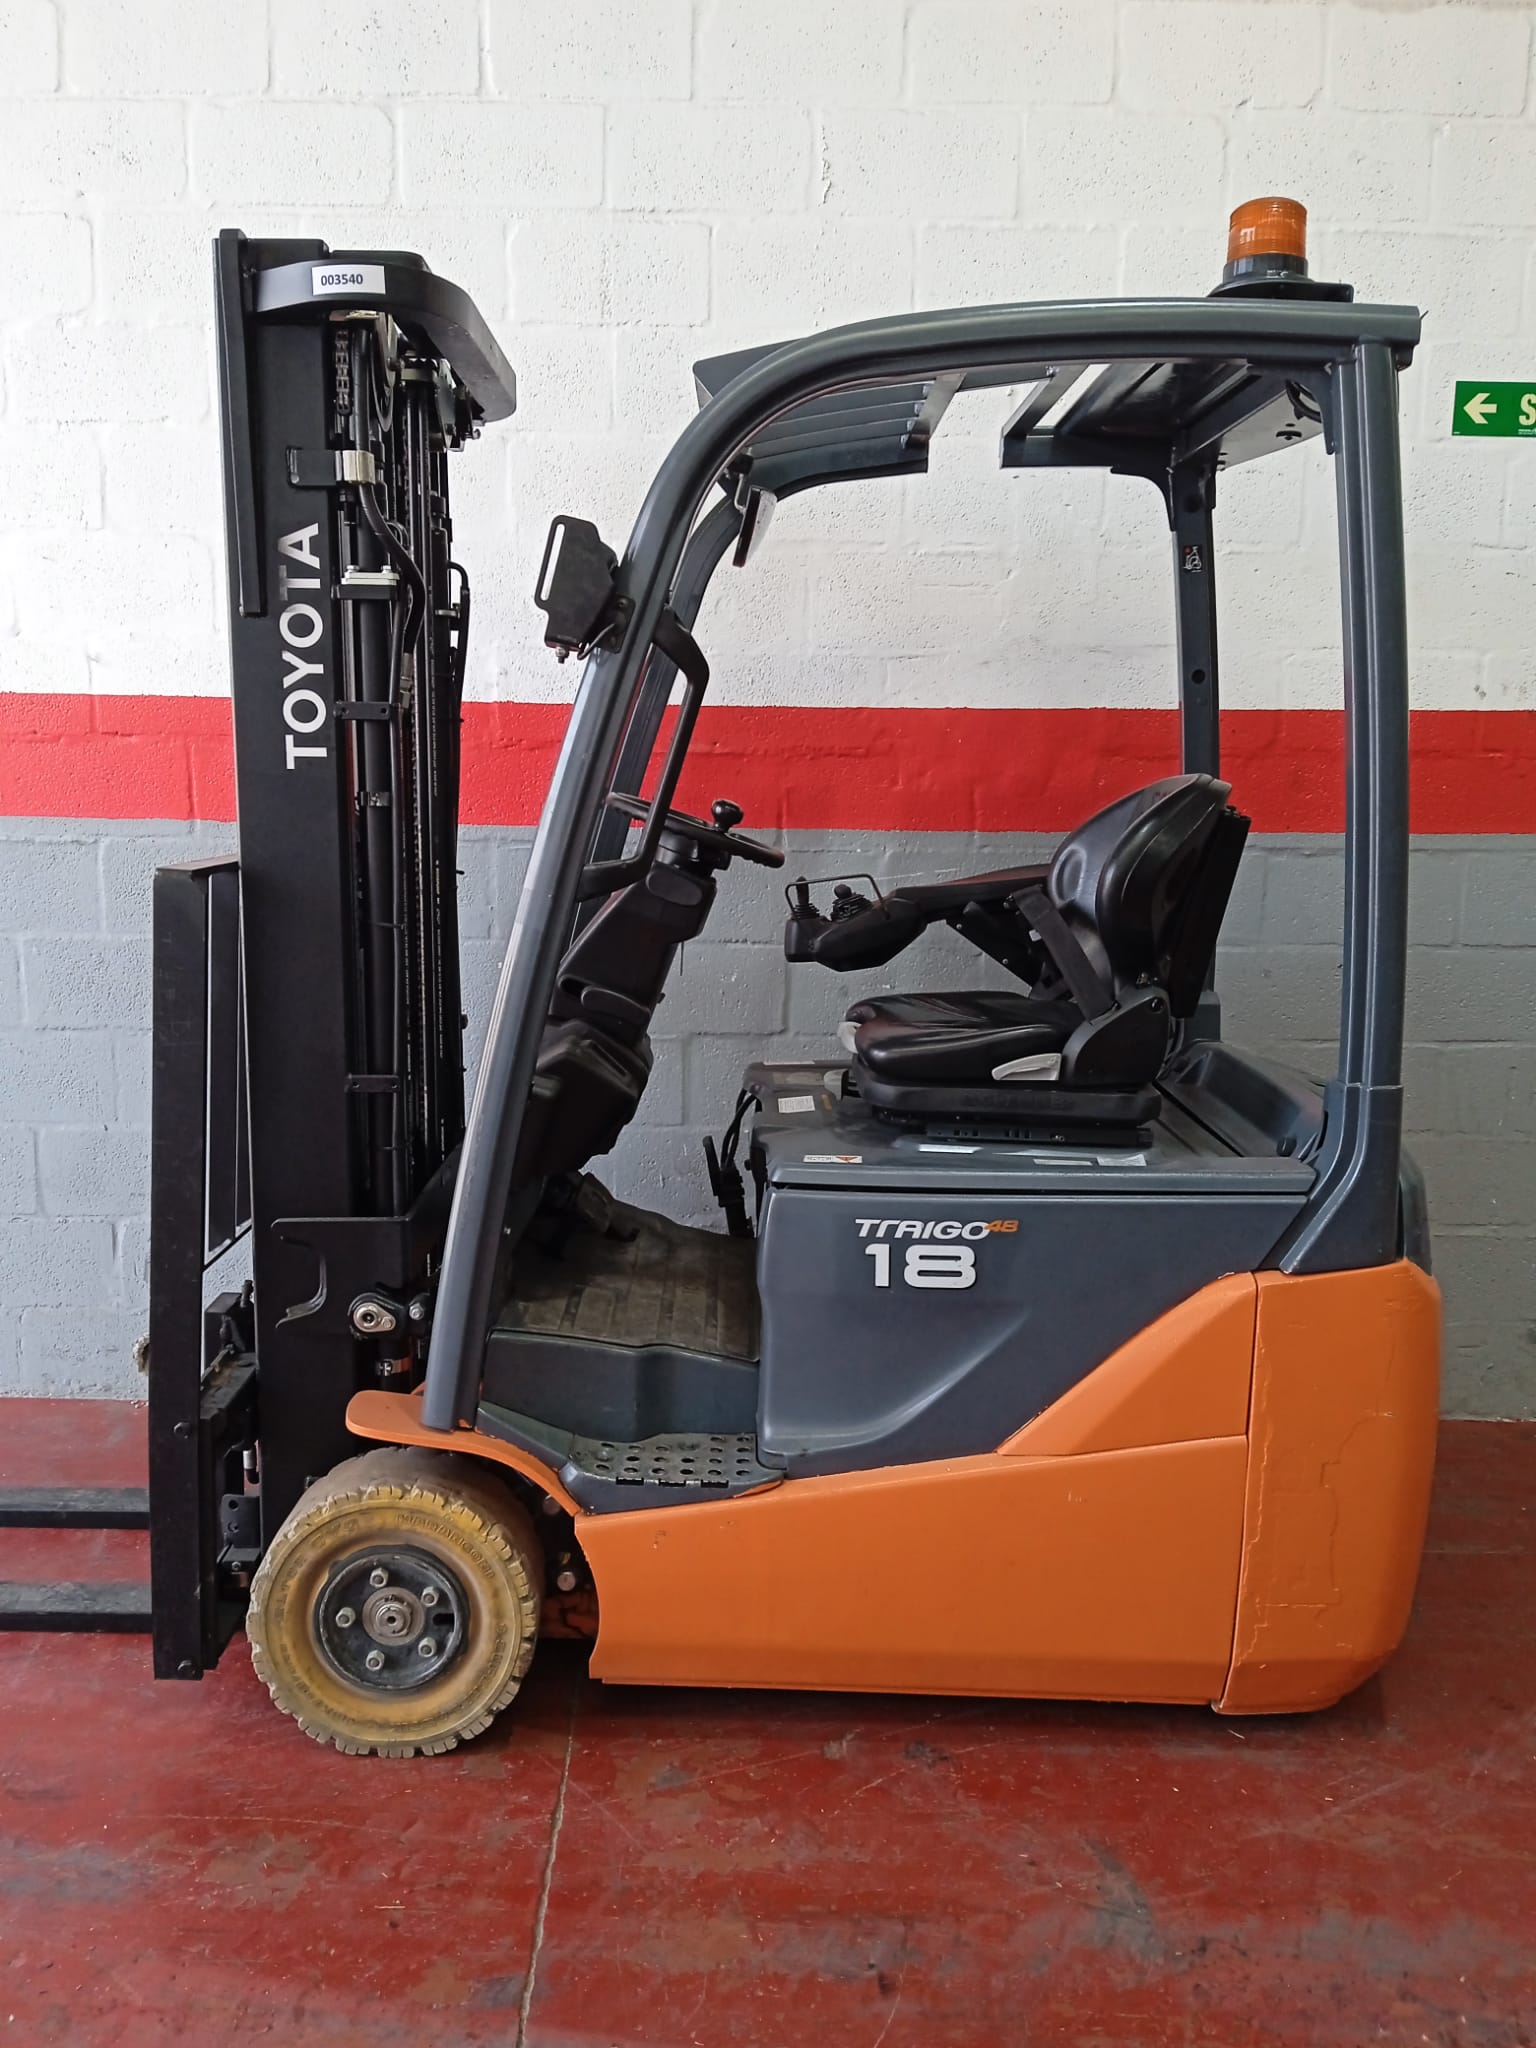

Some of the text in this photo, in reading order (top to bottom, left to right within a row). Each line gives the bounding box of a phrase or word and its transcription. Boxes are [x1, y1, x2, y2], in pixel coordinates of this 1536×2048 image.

[320, 273, 364, 287] 003540
[278, 522, 328, 770] TOYOTA
[855, 1218, 991, 1240] TRAIGO
[865, 1243, 976, 1289] 18
